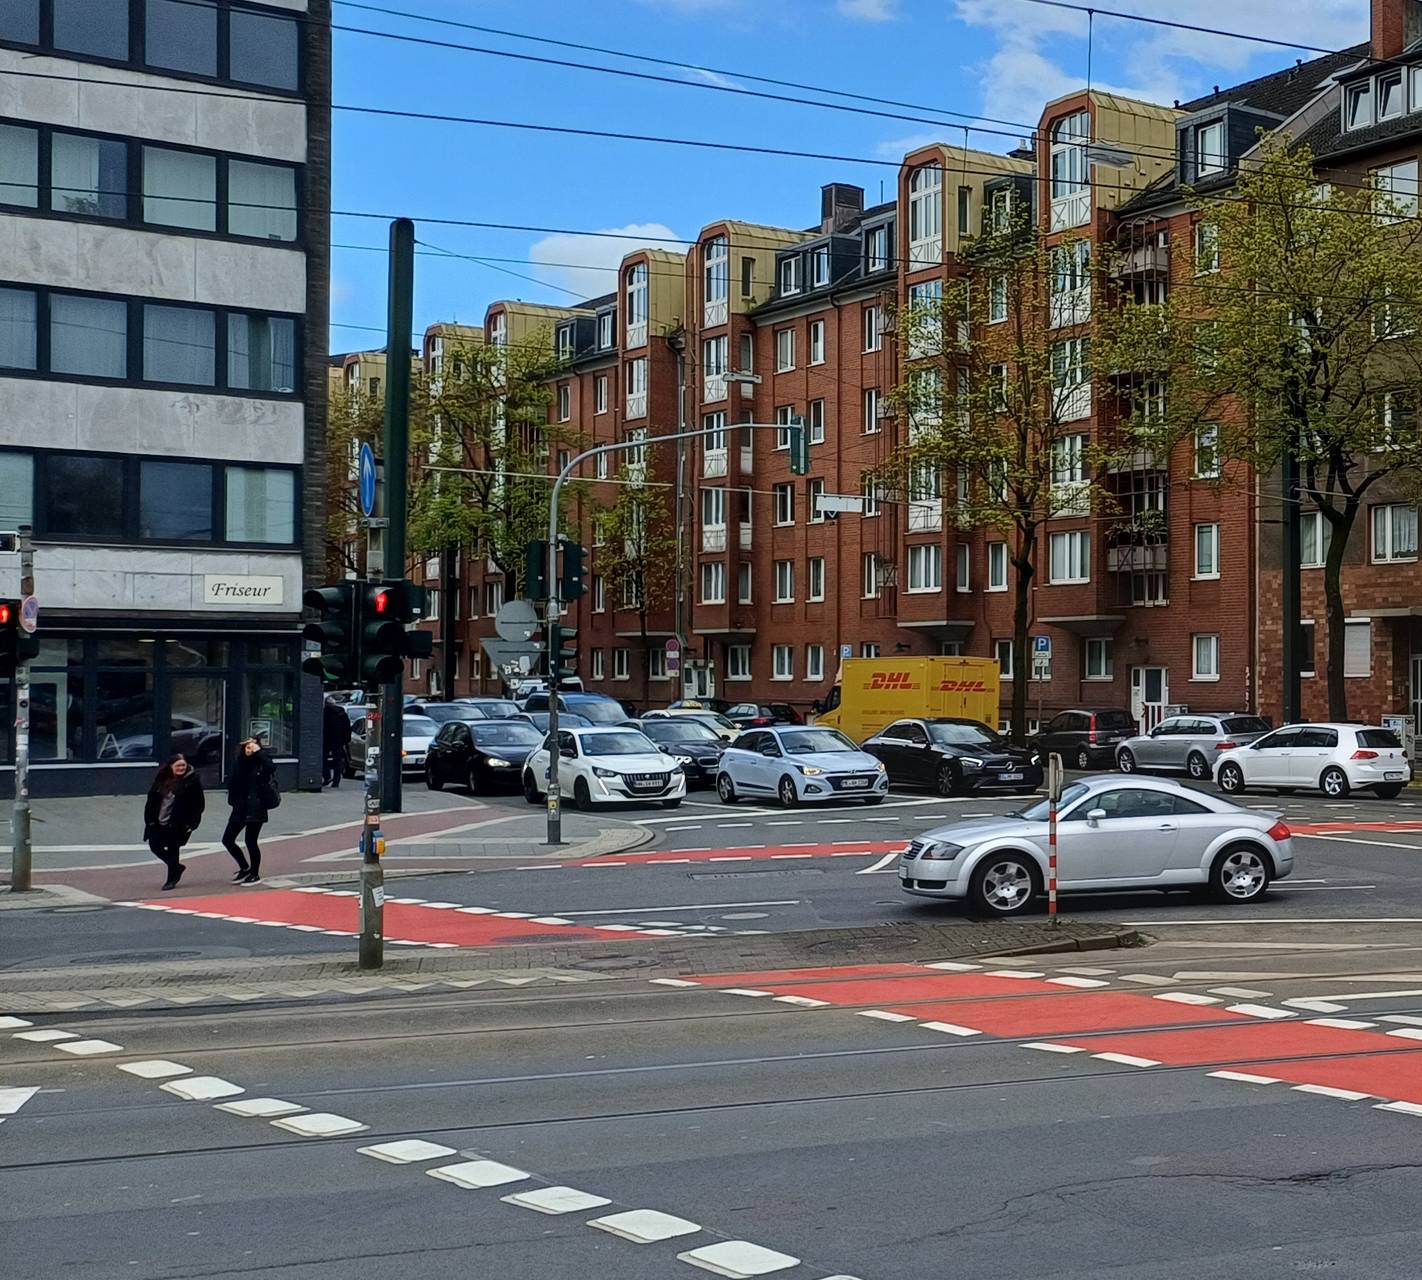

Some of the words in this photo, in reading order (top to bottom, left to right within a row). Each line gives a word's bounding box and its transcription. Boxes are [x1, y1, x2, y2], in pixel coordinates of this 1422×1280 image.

[211, 583, 271, 597] Friseur
[871, 672, 913, 690] DHL
[939, 680, 987, 692] DHL
